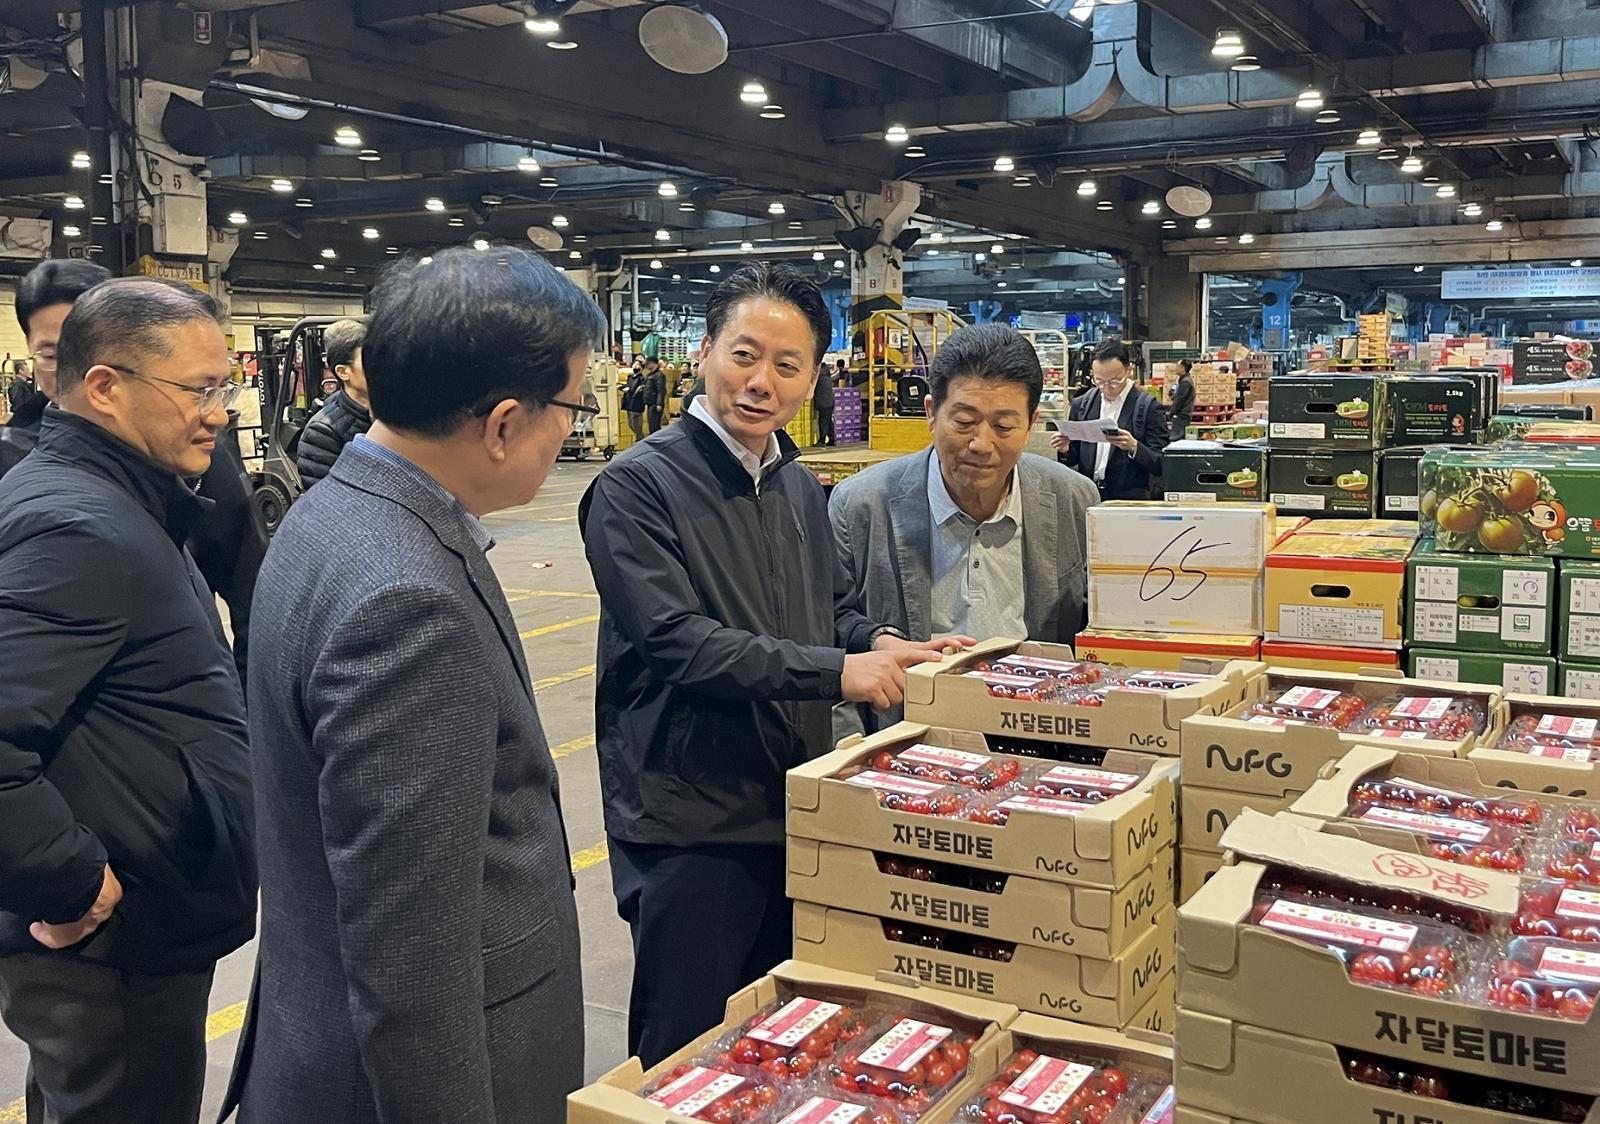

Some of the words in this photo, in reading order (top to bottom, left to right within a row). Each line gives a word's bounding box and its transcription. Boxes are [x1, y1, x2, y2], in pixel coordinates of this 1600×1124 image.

[1268, 315, 1281, 326] 12
[257, 369, 266, 406] TOYOTA
[1446, 389, 1464, 398] 2.5kg
[1139, 525, 1232, 602] 65
[1000, 711, 1091, 738] 자달토마토
[1129, 732, 1168, 748] NFG
[1206, 743, 1292, 778] NFG
[893, 823, 993, 859] 자달토마토
[1127, 812, 1158, 855] NFG
[1035, 856, 1078, 876] NFG
[889, 890, 988, 927] 자달토마토
[1124, 882, 1155, 927] NFG
[1032, 926, 1075, 946] NFG
[893, 955, 995, 994] 자달토마토
[1132, 947, 1162, 996] NFG
[1039, 992, 1083, 1013] NFG
[1374, 1010, 1566, 1074] 자달토마토
